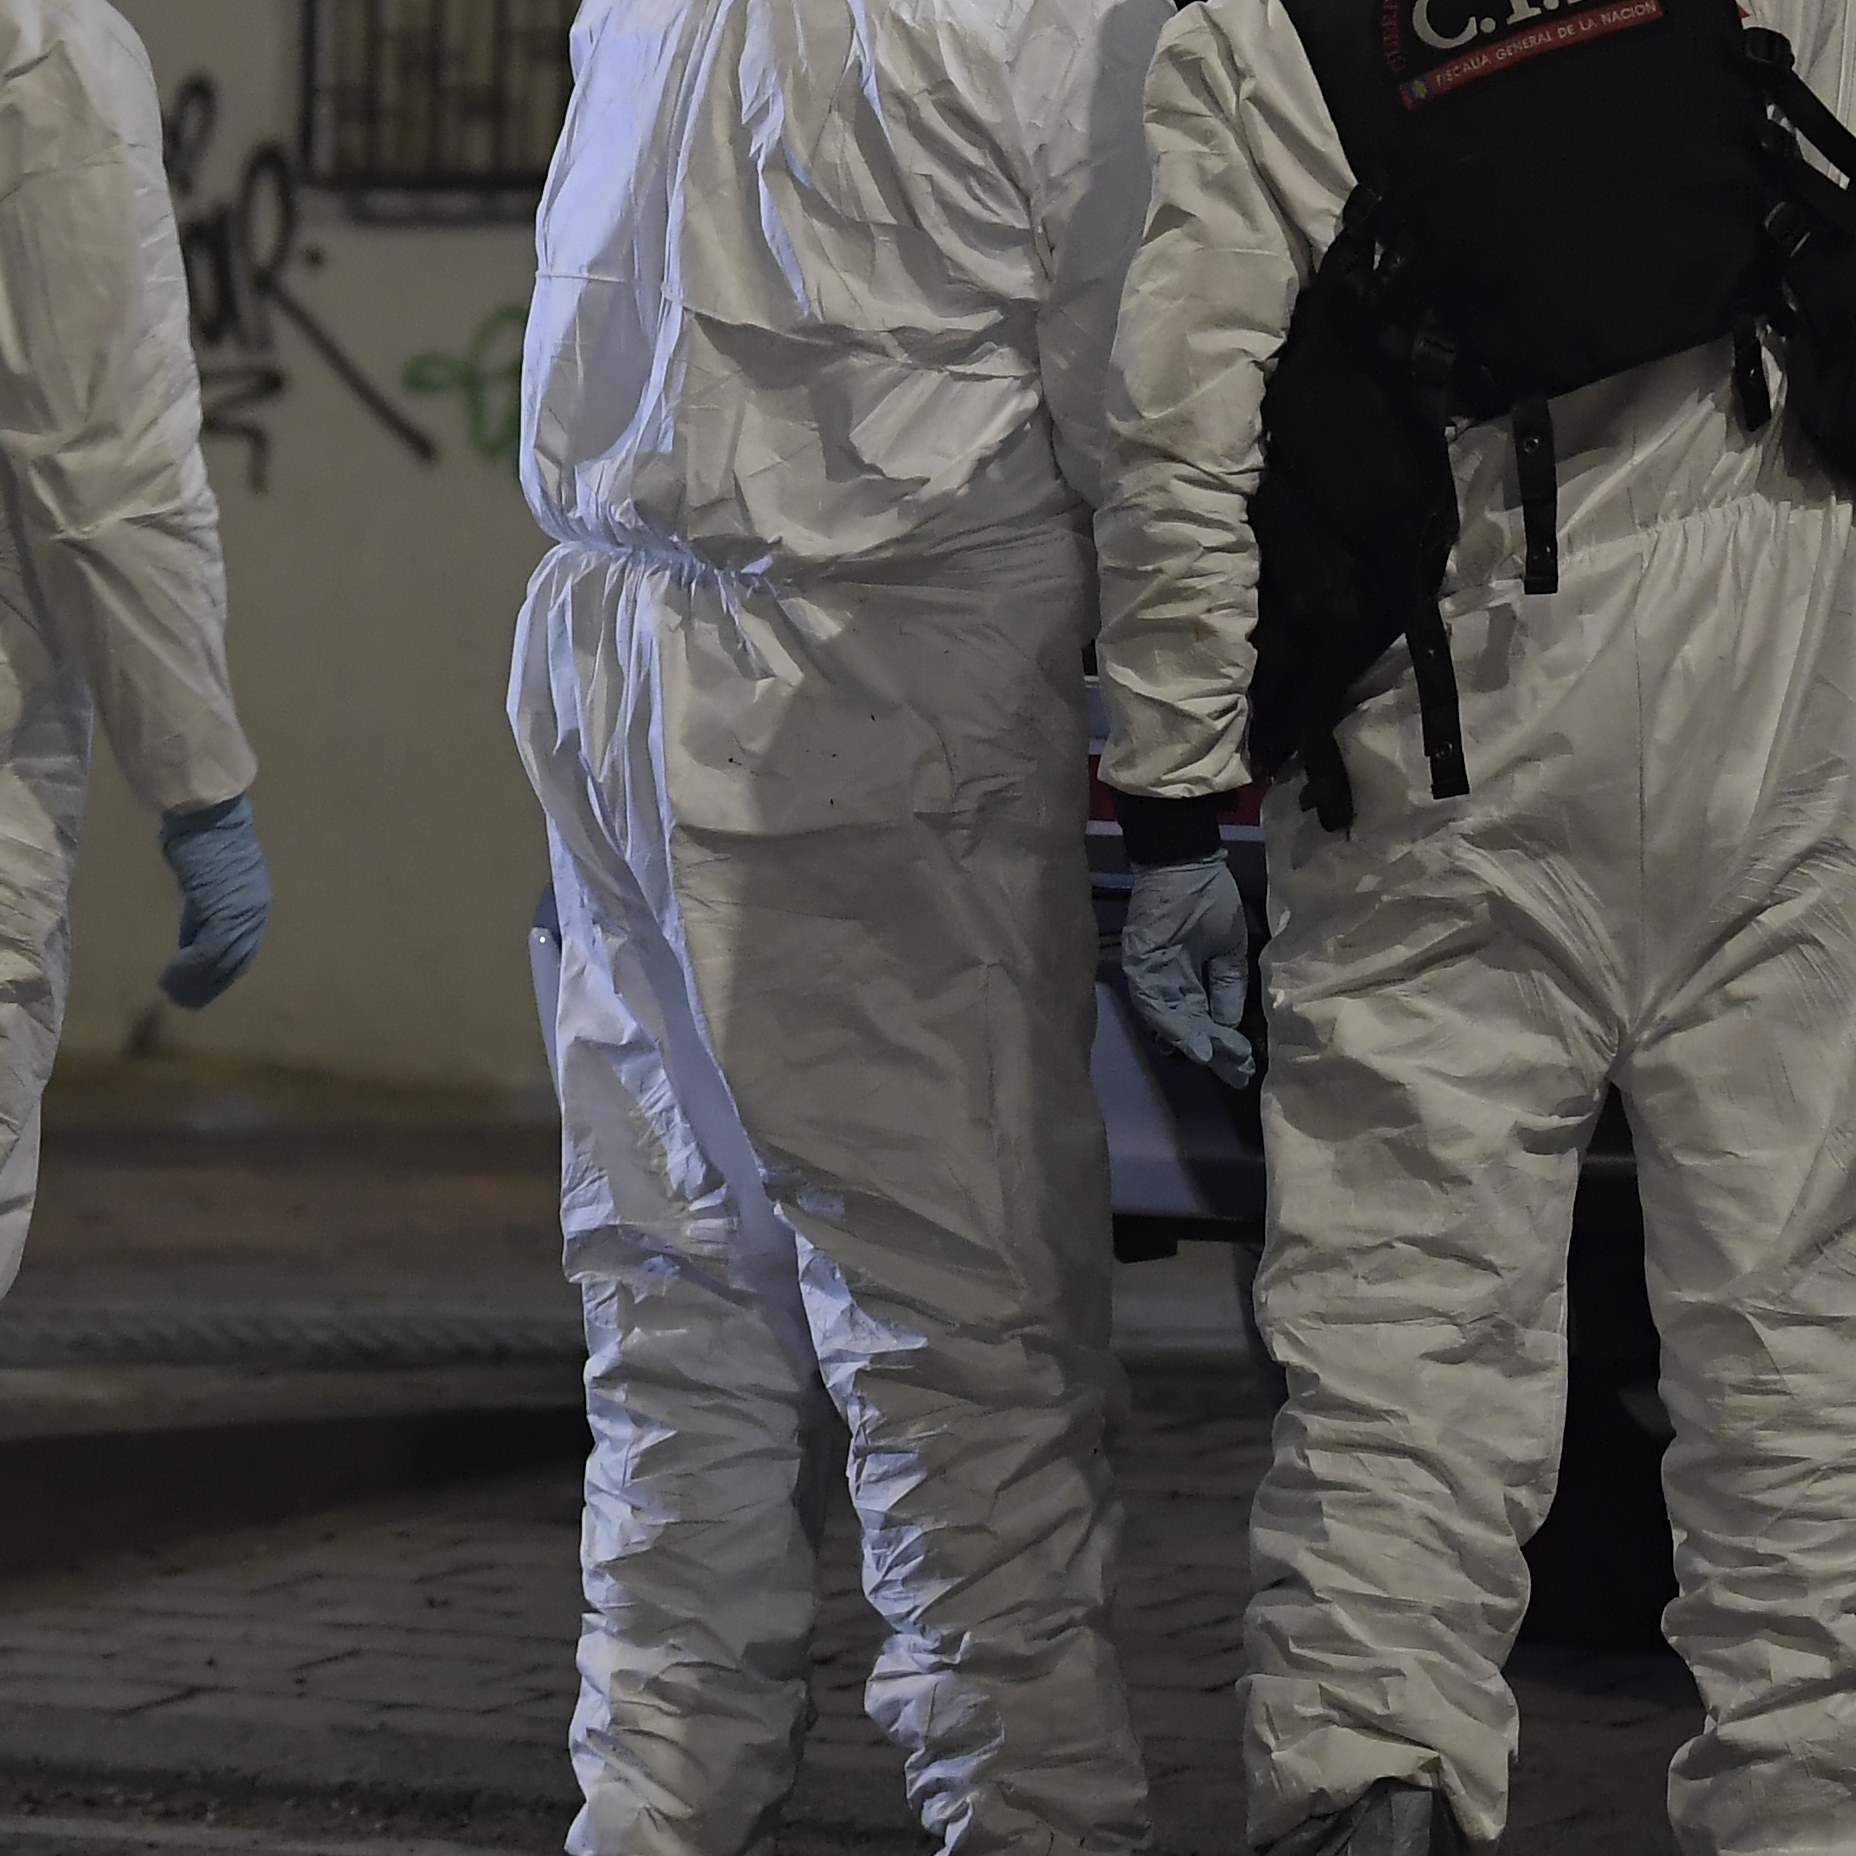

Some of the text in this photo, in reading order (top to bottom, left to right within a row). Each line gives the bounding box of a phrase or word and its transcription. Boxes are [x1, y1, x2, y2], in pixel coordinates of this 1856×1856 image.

[1495, 30, 1553, 62] GENERAL
[1557, 20, 1575, 37] DE
[1579, 15, 1598, 32] LA
[1600, 0, 1658, 27] NACION
